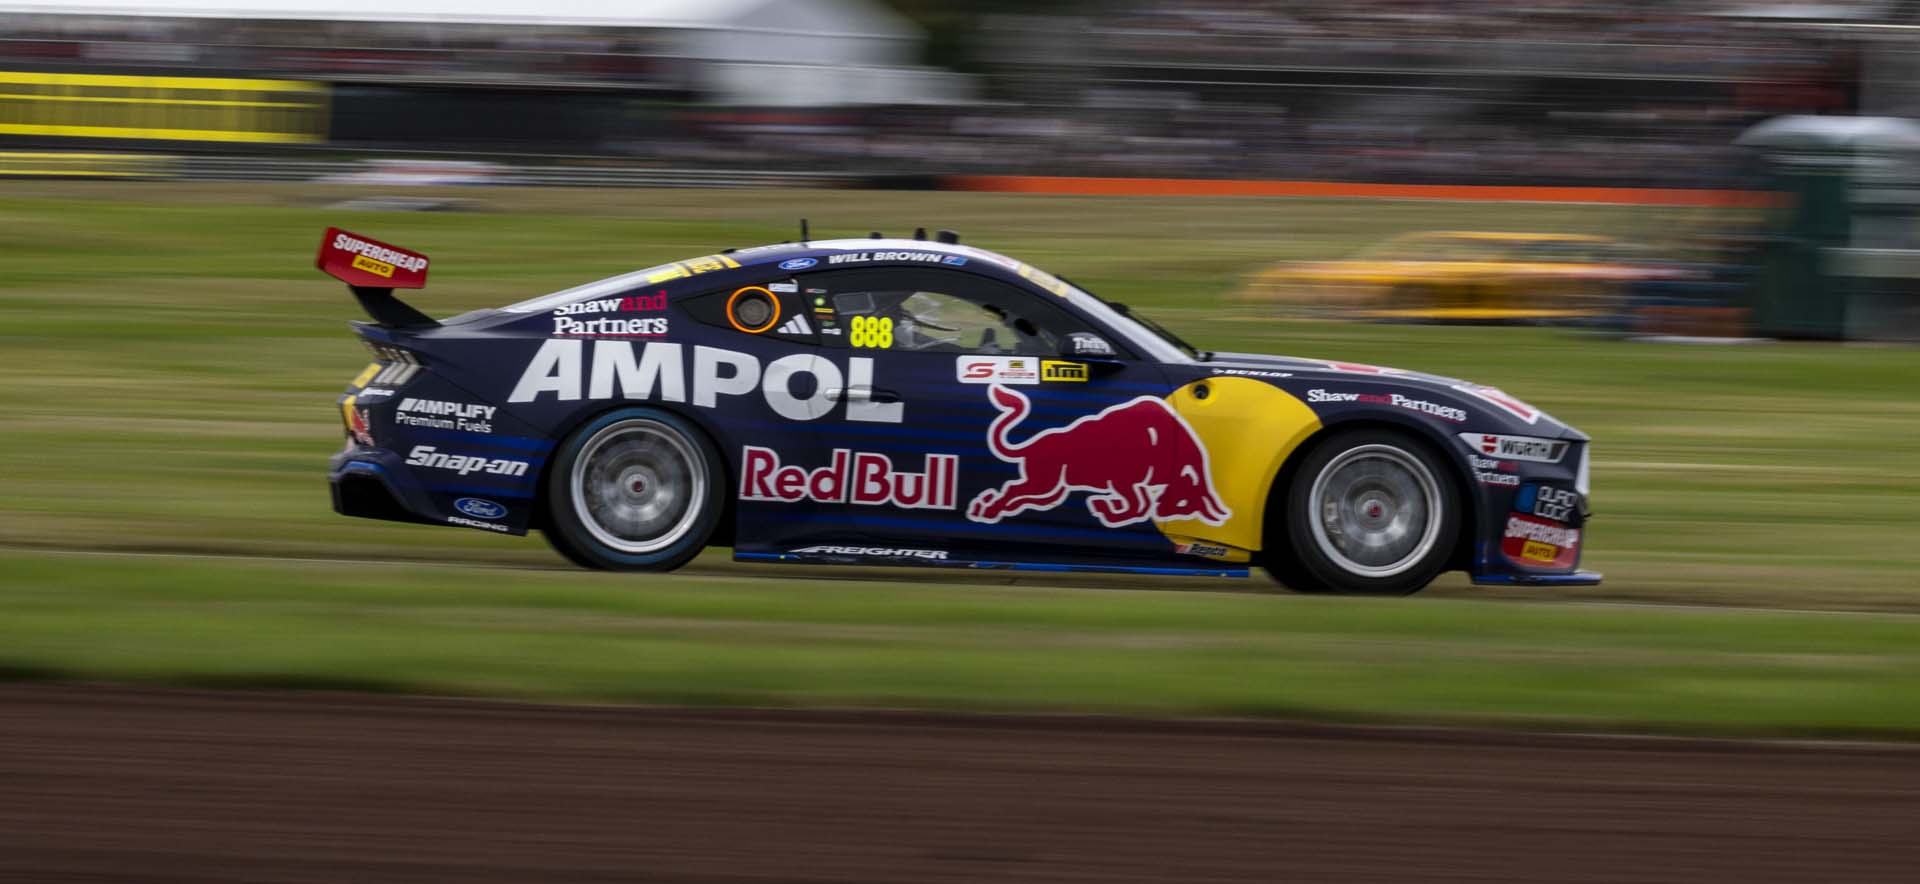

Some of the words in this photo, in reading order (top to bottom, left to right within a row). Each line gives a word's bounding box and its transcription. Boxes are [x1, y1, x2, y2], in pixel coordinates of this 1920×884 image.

[333, 233, 427, 272] SUPERCHEAP
[829, 251, 870, 265] WILL
[873, 251, 943, 263] BROWN
[358, 259, 389, 274] AUTO
[552, 316, 669, 335] Partners
[850, 315, 893, 349] 888
[507, 338, 904, 423] AMPOL
[1224, 369, 1293, 378] DUNLOP
[411, 399, 497, 420] AMPLIFY
[395, 411, 454, 430] Premium
[456, 418, 492, 433] Fuels
[447, 516, 509, 532] RACING
[807, 545, 949, 560] FREIGHTER
